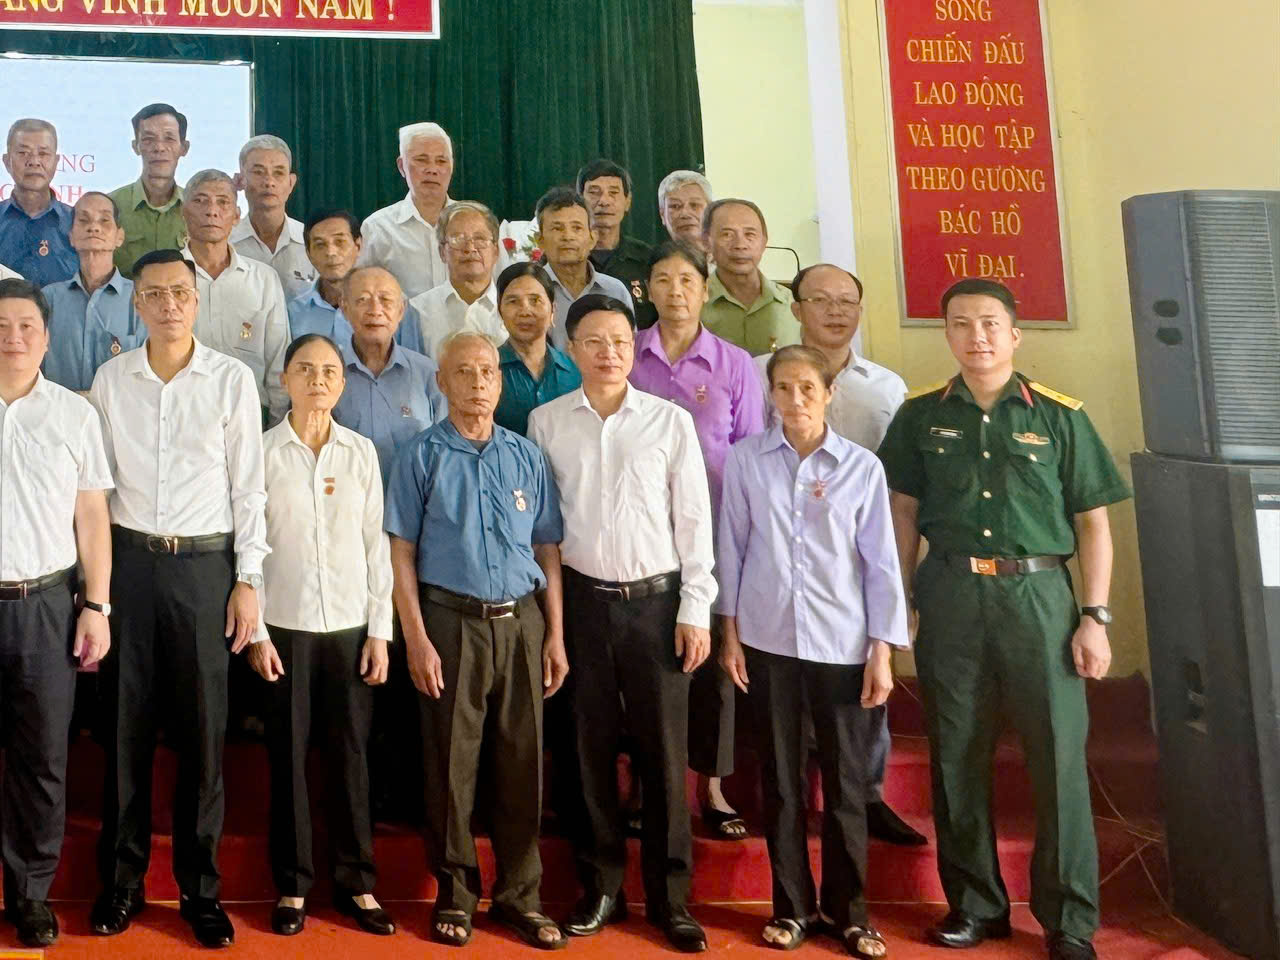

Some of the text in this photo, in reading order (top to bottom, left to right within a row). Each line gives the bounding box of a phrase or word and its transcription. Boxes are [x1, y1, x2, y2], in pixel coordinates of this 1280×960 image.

[906, 31, 1025, 65] CHIẾN ĐẤU
[913, 75, 1025, 112] LAO ĐỘNG
[906, 117, 1036, 155] VÀ HỌC TẬP
[905, 164, 1047, 193] THEO GƯƠNG
[938, 202, 1022, 236] BÁC HỒ
[944, 247, 969, 278] VĨ
